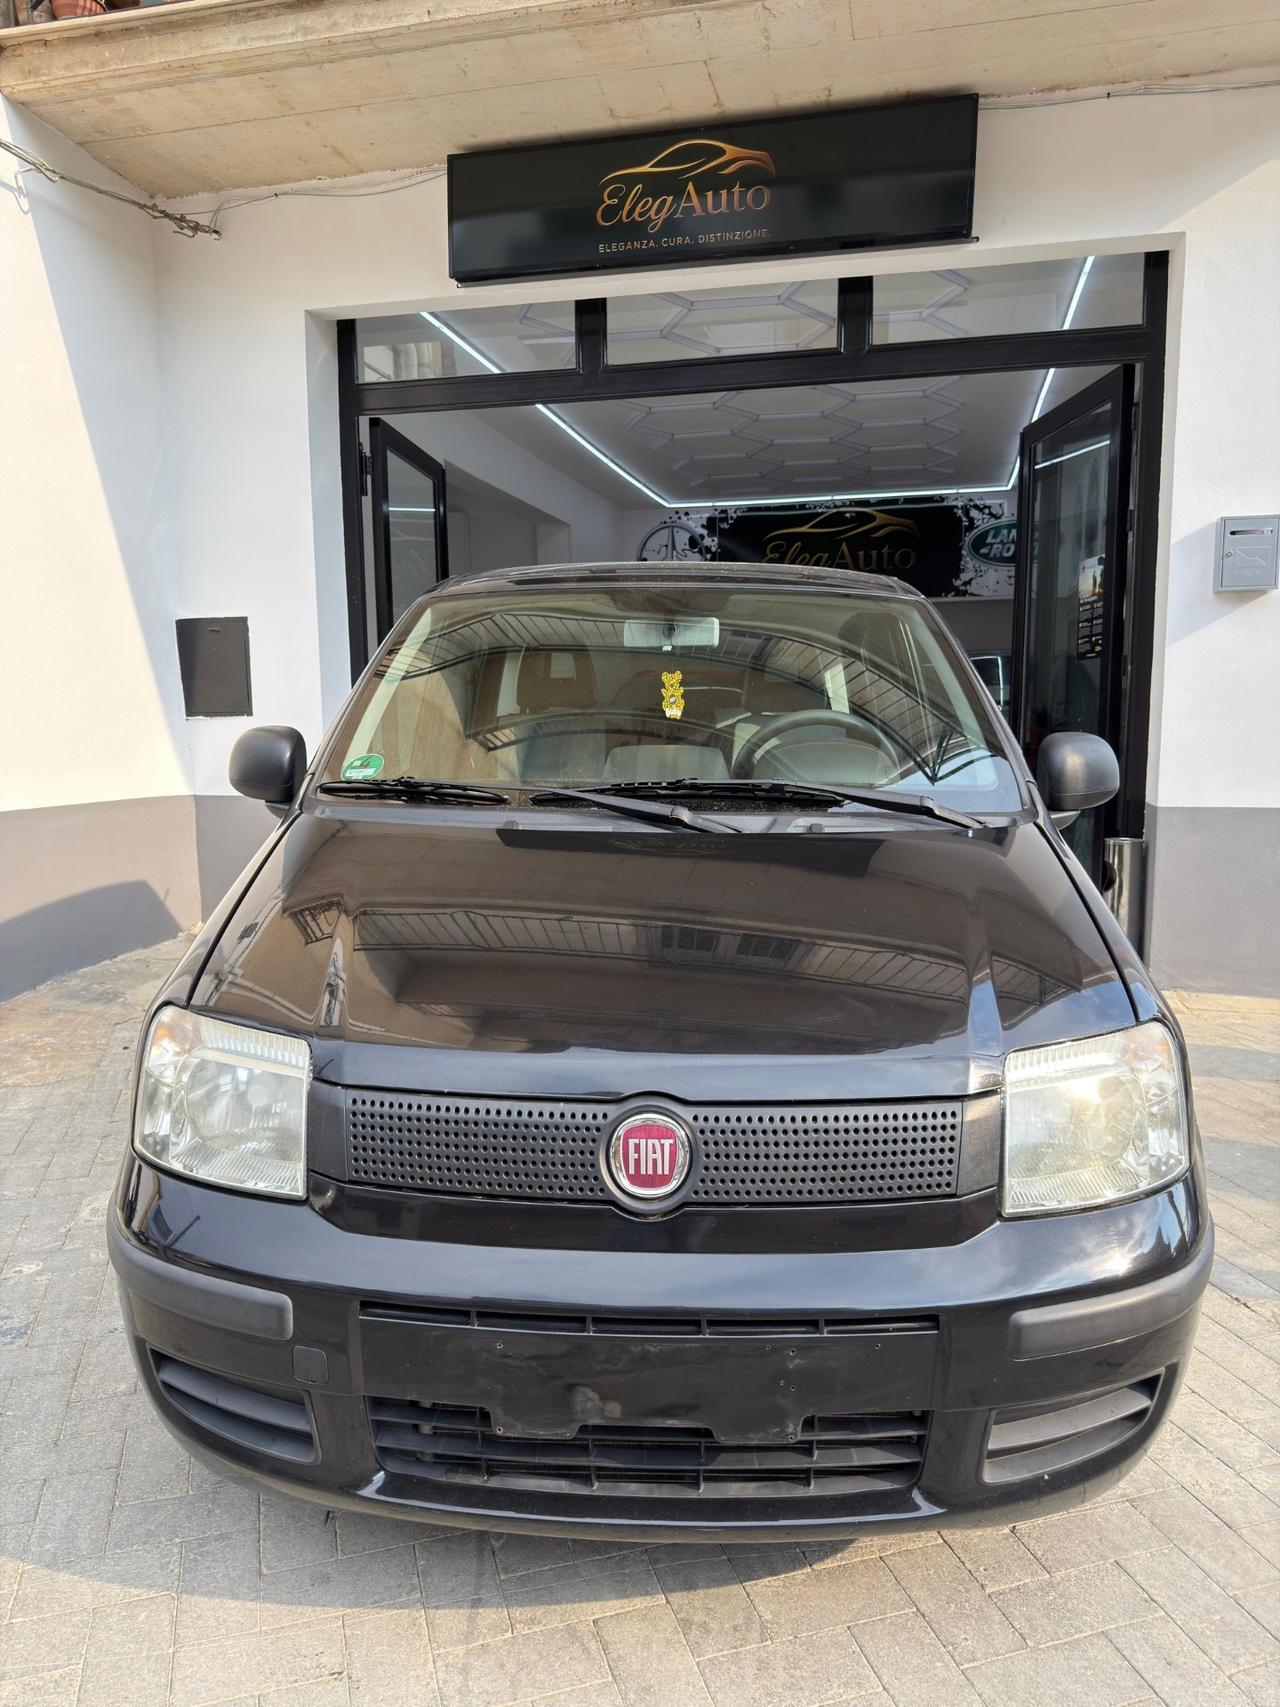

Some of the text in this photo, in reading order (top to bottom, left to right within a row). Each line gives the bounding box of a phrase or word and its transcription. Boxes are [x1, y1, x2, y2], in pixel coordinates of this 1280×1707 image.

[596, 181, 771, 233] ElegAuto
[599, 228, 772, 253] ELEGANZA. CURA. DISTINZIONE.
[985, 528, 1017, 544] LAN
[628, 1138, 674, 1175] FIAT
